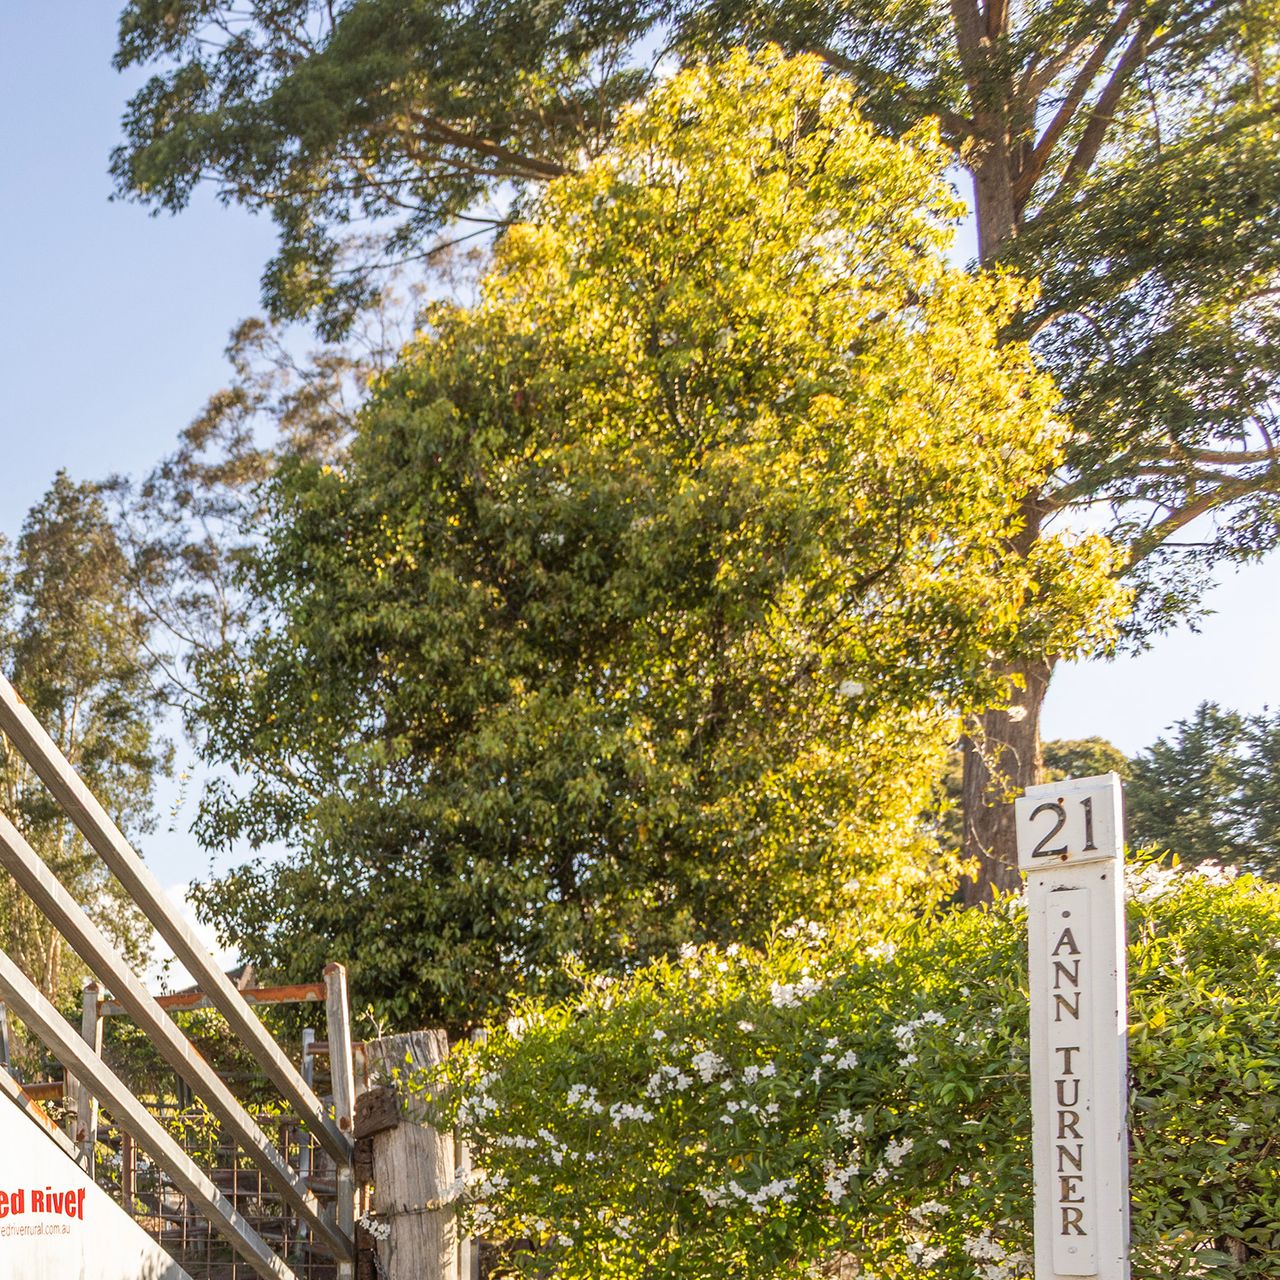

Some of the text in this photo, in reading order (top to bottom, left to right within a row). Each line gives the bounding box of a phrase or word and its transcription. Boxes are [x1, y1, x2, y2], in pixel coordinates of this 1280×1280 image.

[1029, 796, 1098, 859] 21
[1051, 927, 1087, 1237] ANN TURNER
[31, 1186, 85, 1220] River
